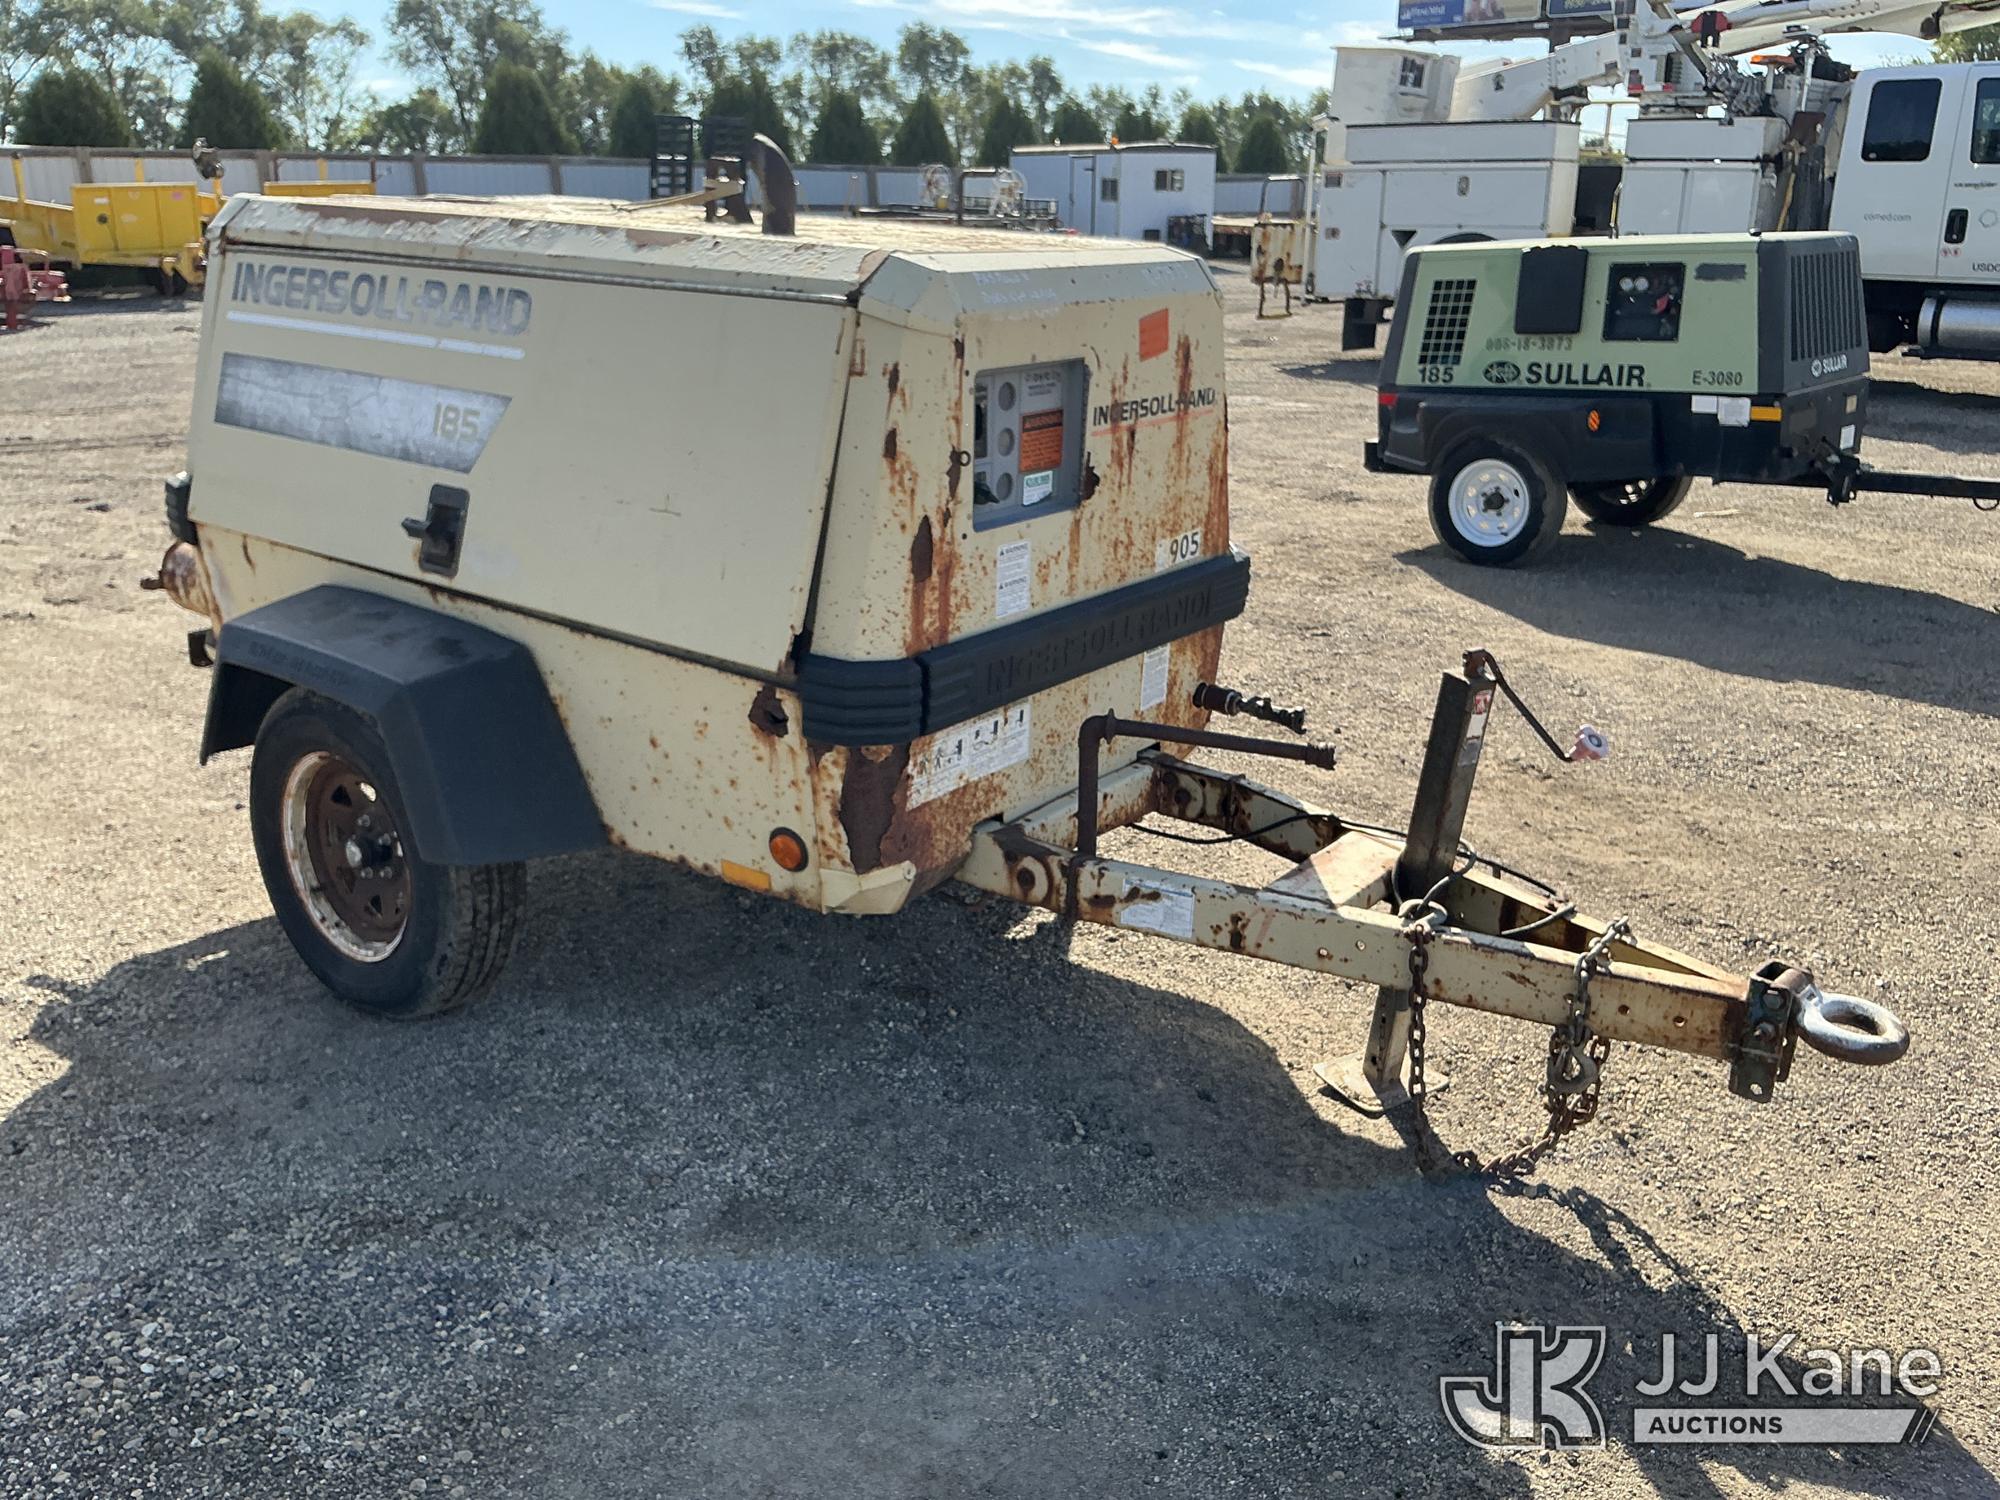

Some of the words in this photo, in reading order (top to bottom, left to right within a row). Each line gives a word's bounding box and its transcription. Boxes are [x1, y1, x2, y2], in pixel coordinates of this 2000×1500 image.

[231, 261, 533, 337] INGERSOLL-RAND
[1418, 366, 1454, 384] 185
[1525, 361, 1646, 388] SULLAIR
[1692, 369, 1743, 386] E-3080
[1822, 354, 1848, 374] SULLAIR
[433, 401, 481, 440] 185
[1170, 531, 1199, 564] 905
